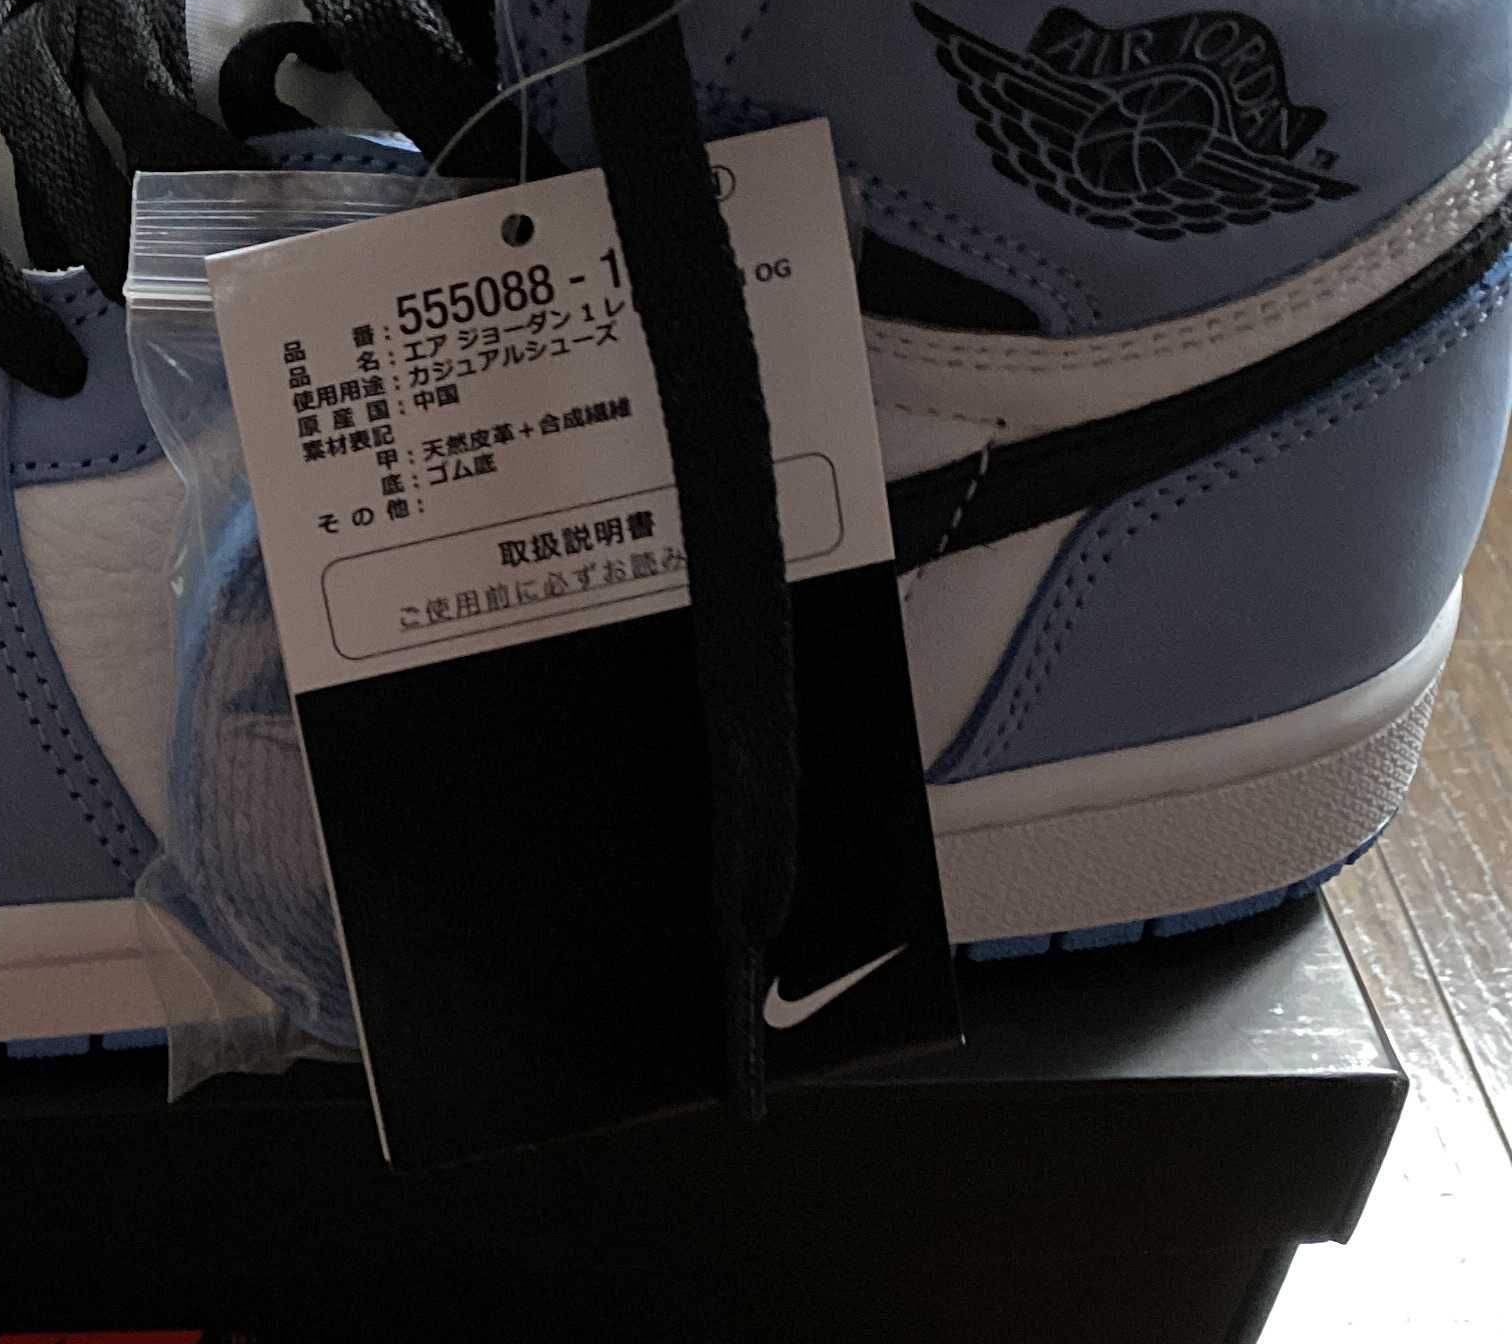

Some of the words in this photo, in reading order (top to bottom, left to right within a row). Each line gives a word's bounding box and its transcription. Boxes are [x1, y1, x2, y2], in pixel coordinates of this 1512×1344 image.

[1043, 27, 1153, 75] AIR
[754, 257, 791, 282] OG
[396, 263, 555, 336] 555088
[302, 423, 395, 463] 素材表記
[498, 509, 656, 568] 取扱説明書
